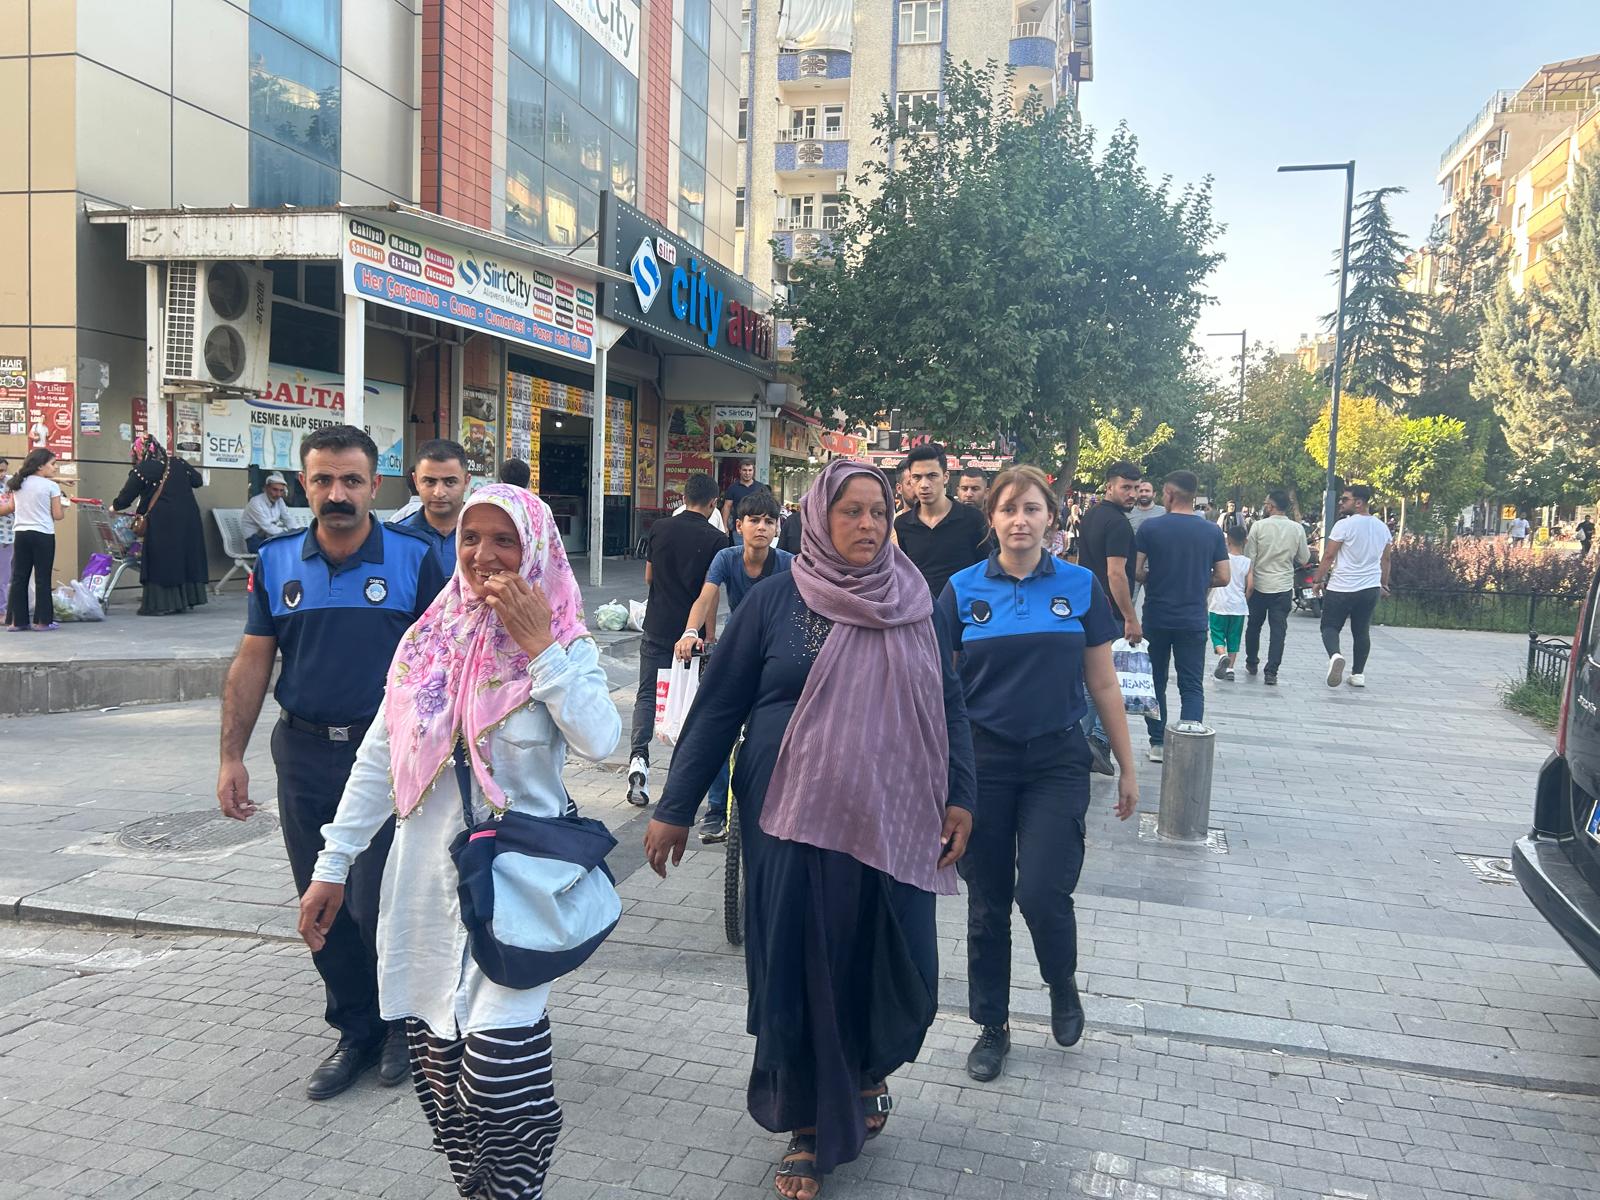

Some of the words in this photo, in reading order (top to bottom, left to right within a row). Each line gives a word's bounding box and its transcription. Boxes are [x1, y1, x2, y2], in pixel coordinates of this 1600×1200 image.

[351, 221, 384, 244] Bakliyat
[391, 234, 419, 256] Manav
[658, 243, 677, 265] siirt
[483, 261, 531, 307] SiirtCity
[361, 267, 383, 291] Her
[386, 275, 440, 309] Çarşamba
[450, 296, 477, 319] Cuma
[485, 308, 525, 335] Cumartesi
[532, 323, 554, 342] Pazar
[671, 257, 723, 348] city
[728, 300, 774, 360] avm
[251, 411, 280, 426] KESME
[282, 415, 289, 427] &
[290, 413, 307, 429] KÜP
